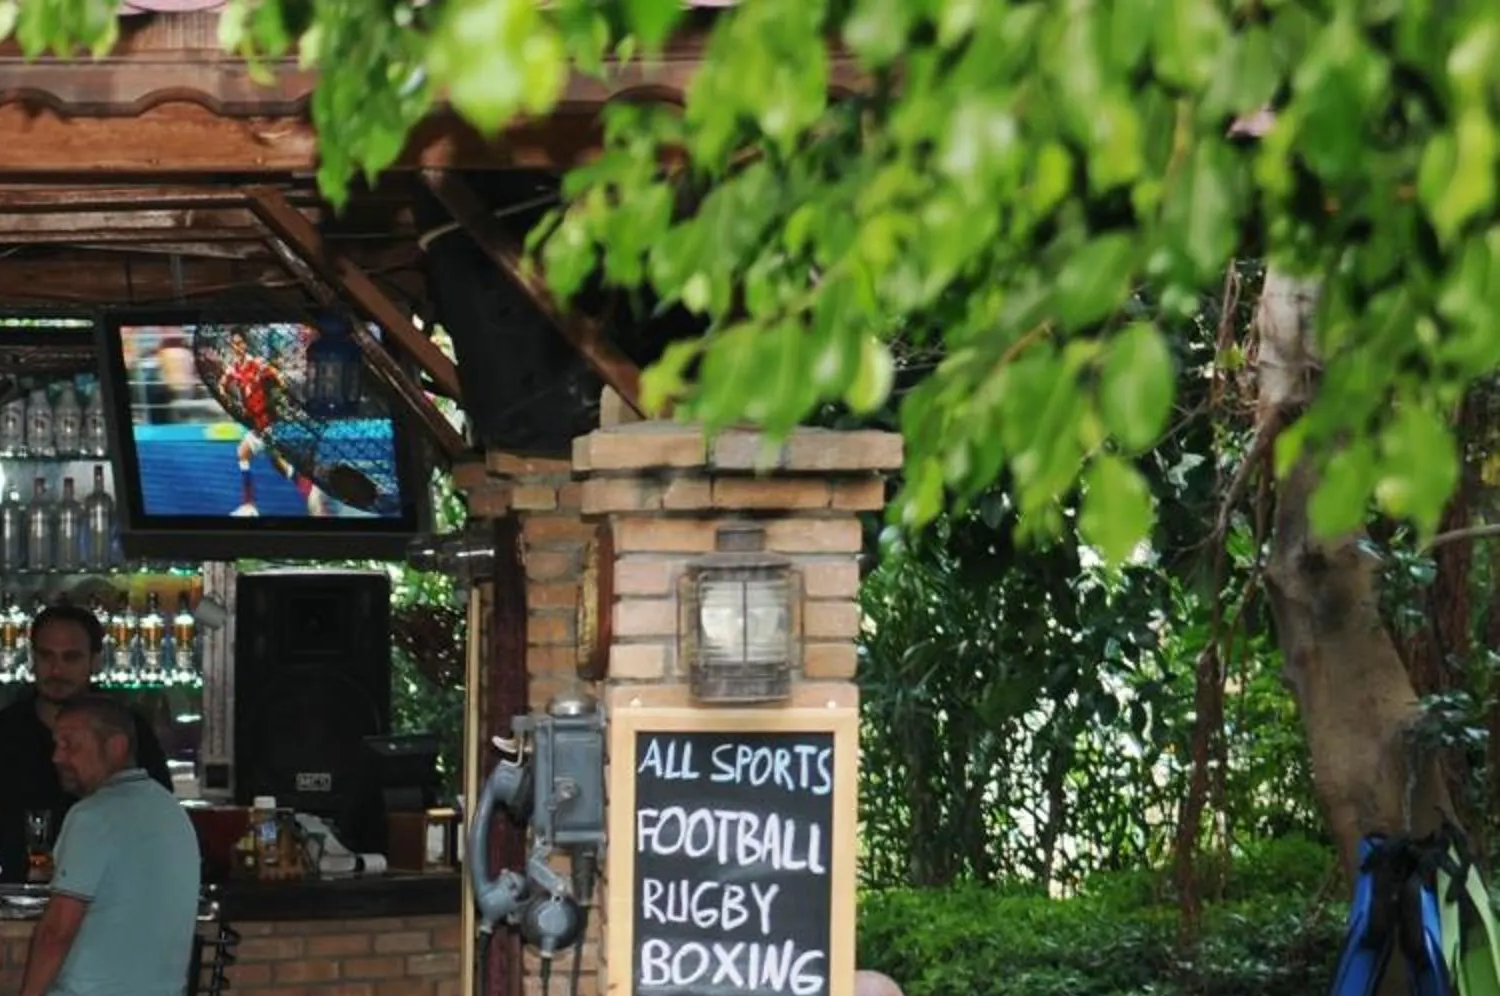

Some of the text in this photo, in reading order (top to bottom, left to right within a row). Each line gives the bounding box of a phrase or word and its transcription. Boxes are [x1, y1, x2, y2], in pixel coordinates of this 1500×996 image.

[637, 738, 832, 795] ALL SPORTS
[636, 805, 825, 875] FOOTBALL
[642, 877, 780, 935] RUGBY
[639, 938, 825, 996] BOXING
